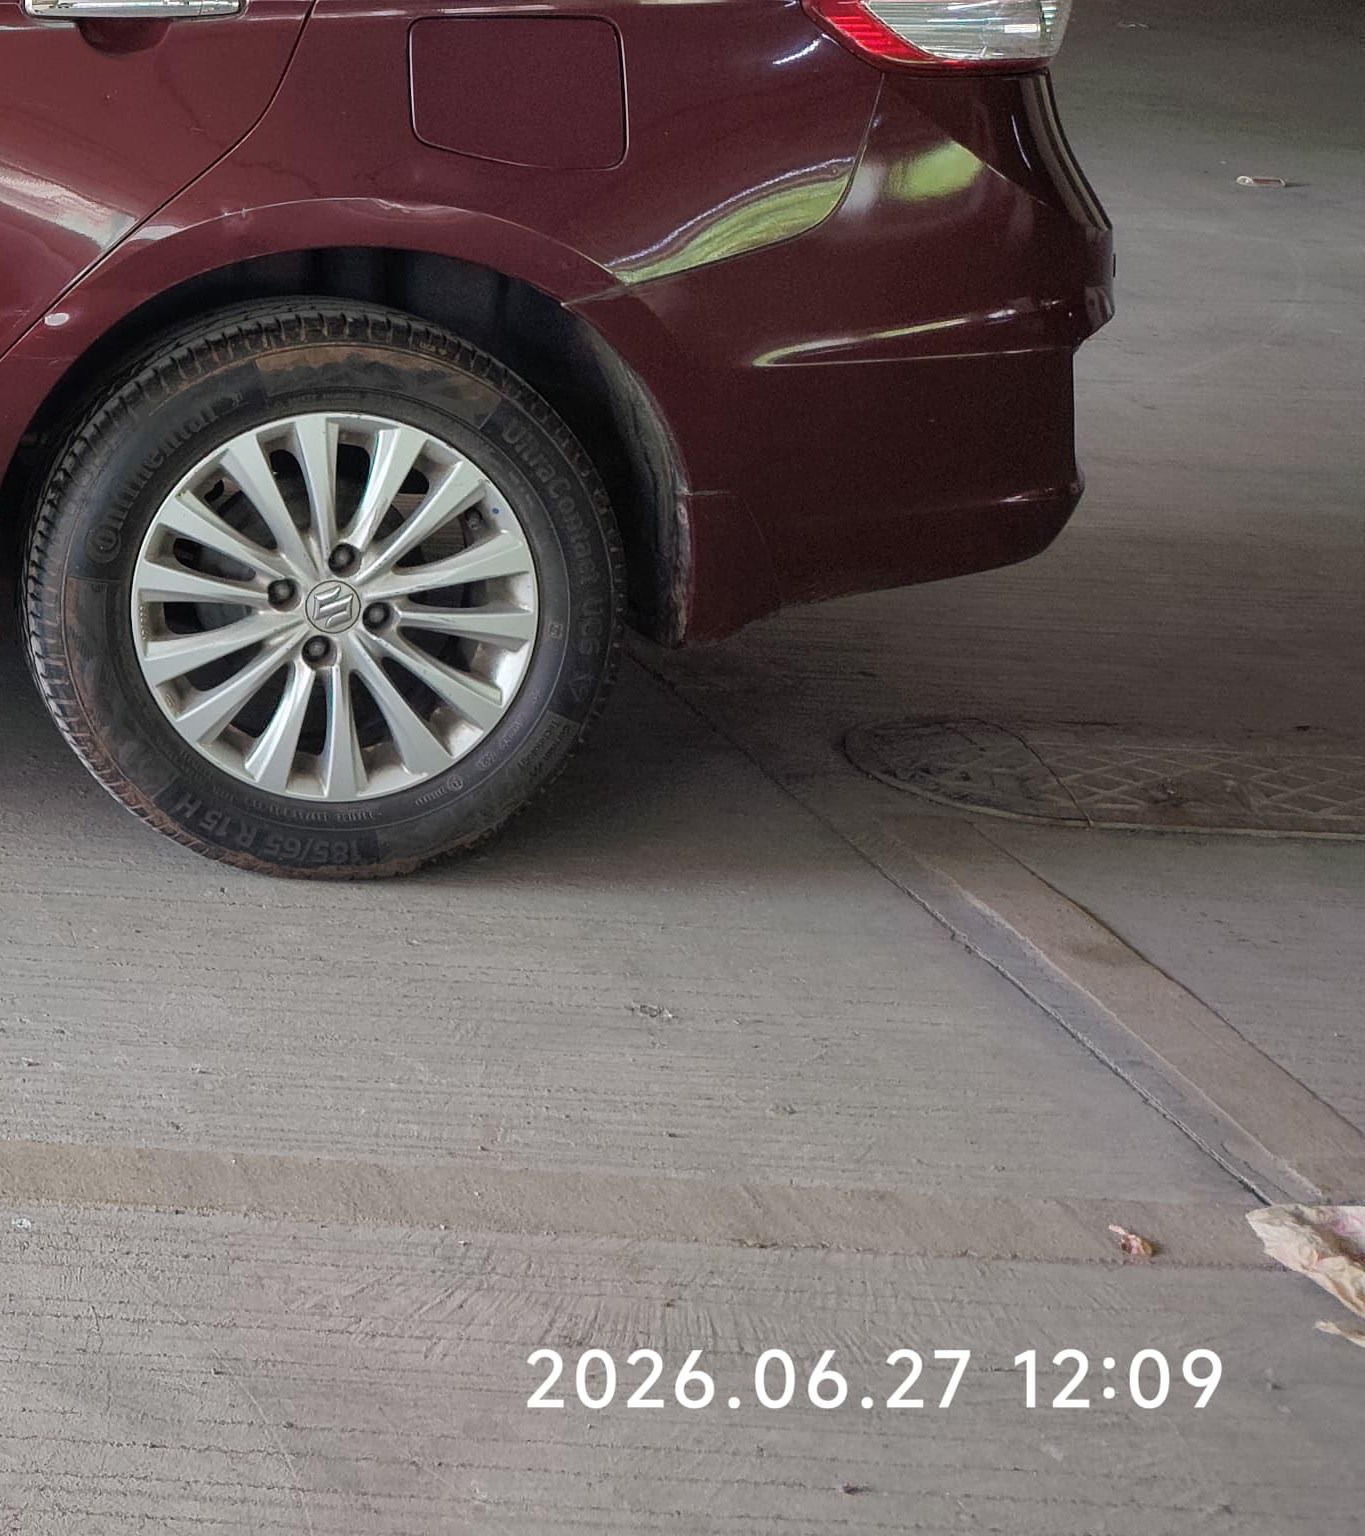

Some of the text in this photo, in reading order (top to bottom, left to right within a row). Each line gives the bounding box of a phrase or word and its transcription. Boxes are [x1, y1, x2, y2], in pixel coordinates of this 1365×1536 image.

[175, 792, 203, 818] H
[199, 812, 233, 837] 15
[240, 823, 258, 849] R
[260, 838, 360, 865] 185/65
